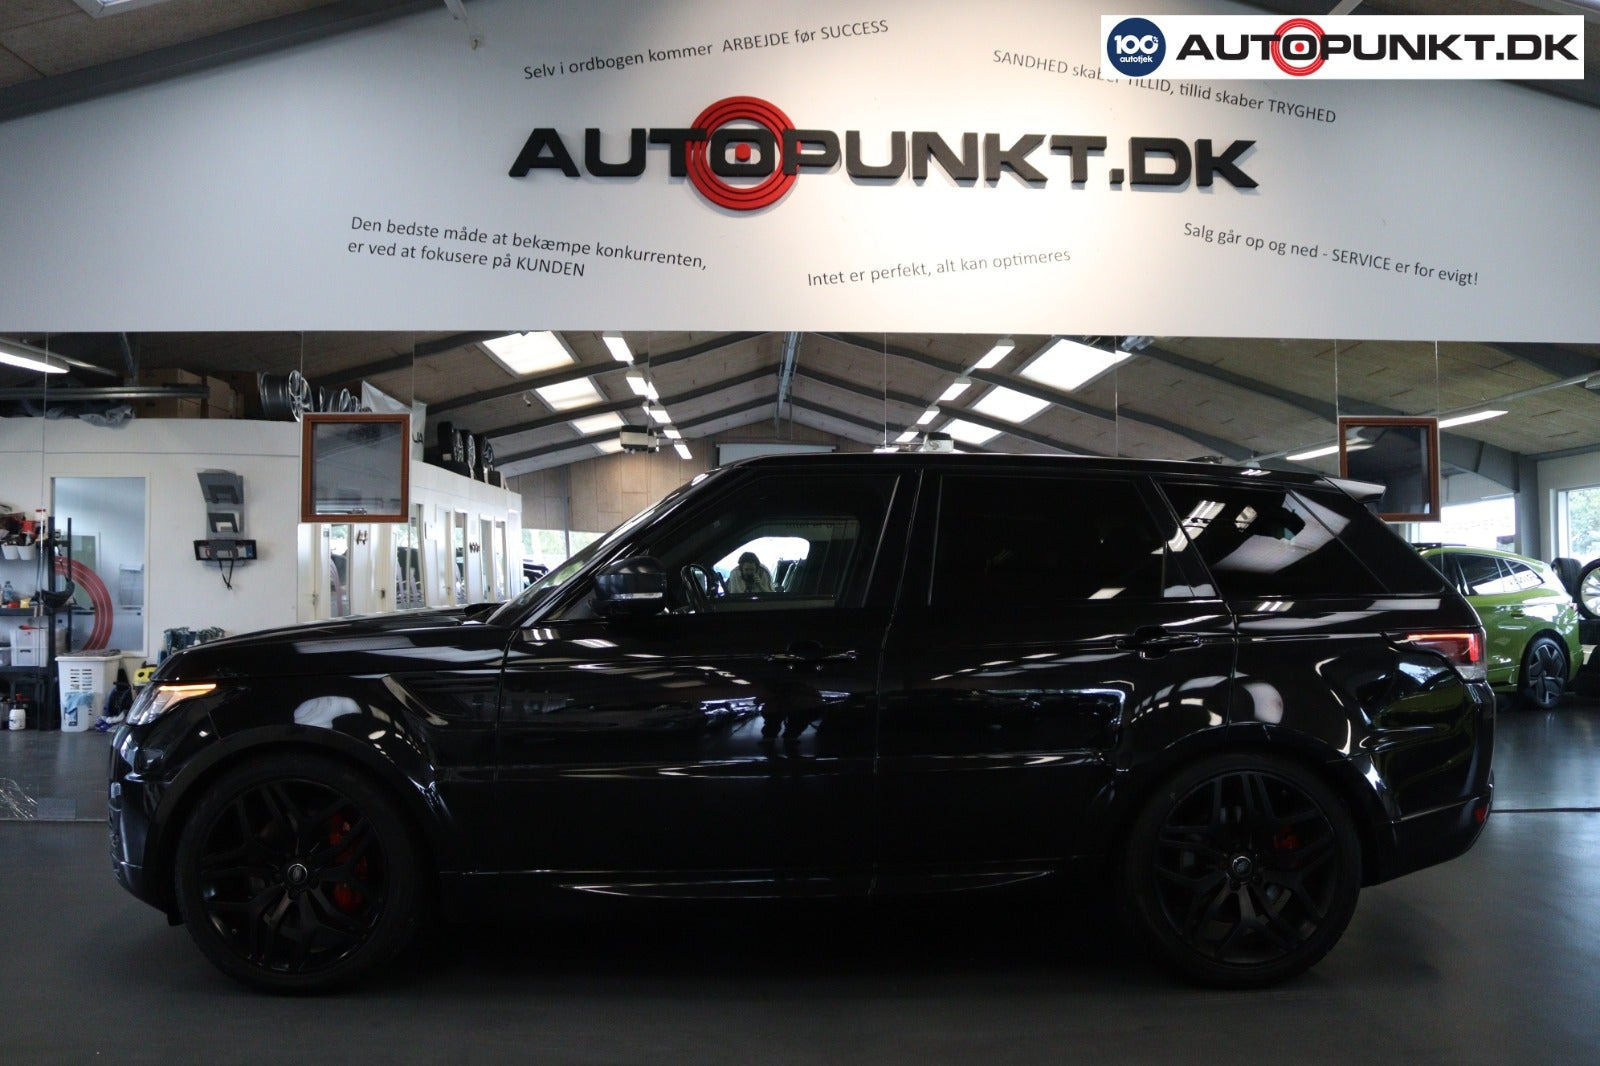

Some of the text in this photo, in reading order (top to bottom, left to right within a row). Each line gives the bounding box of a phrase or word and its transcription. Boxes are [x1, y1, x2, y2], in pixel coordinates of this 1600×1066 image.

[524, 19, 889, 80] Selv i ordbogen kommer ARBEJDE før SUCCESS
[993, 49, 1068, 75] SANDHED
[1072, 62, 1119, 84] ska
[1179, 82, 1211, 101] tillid
[1215, 91, 1264, 112] skaber
[1268, 99, 1337, 125] TRYGHED
[508, 127, 1258, 190] AUTOPUNKT.DK
[348, 241, 586, 278] er ved at fokusere på KUNDEN
[351, 215, 708, 272] Den bedste måde at bekæmpe konkurrenten,
[807, 249, 1071, 287] Intet er perfekt, alt kan optimeres
[1183, 222, 1214, 243] Salg
[1217, 229, 1242, 245] går
[1245, 235, 1265, 251] op
[1268, 239, 1287, 256] og
[1290, 242, 1319, 259] ned
[1331, 248, 1391, 272] SERVICE
[1395, 260, 1411, 273] er
[1414, 261, 1435, 279] for
[1438, 268, 1478, 287] evigt!
